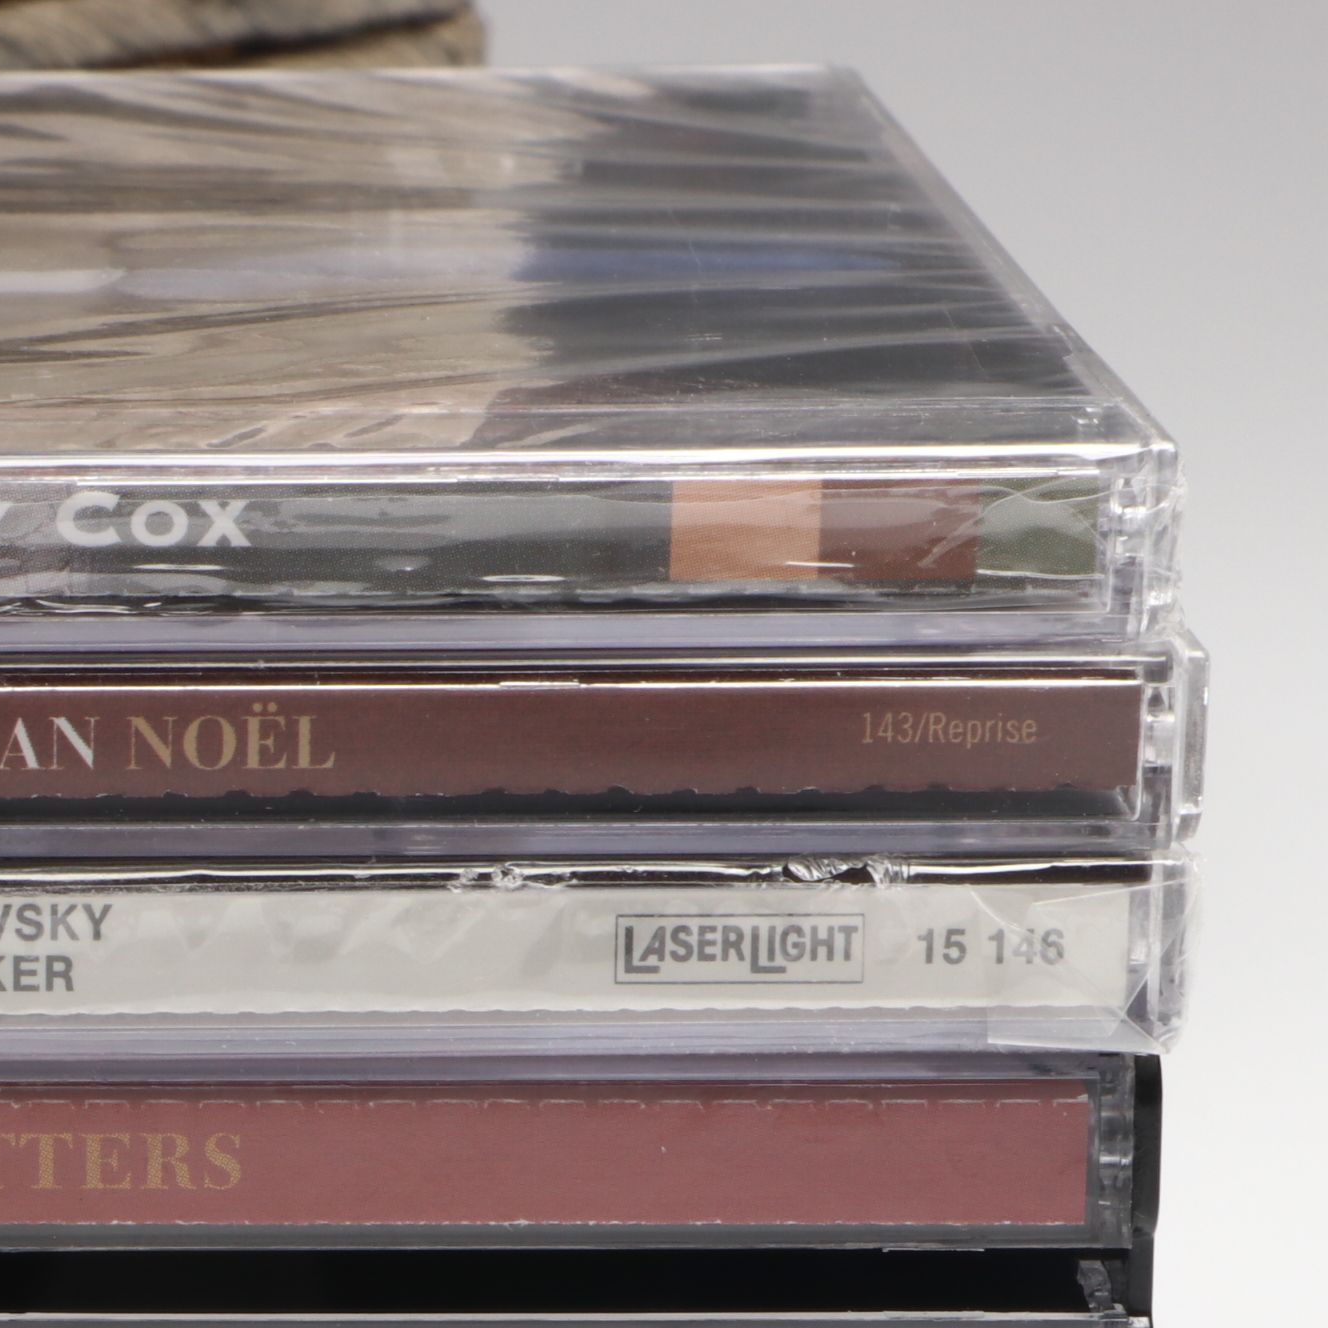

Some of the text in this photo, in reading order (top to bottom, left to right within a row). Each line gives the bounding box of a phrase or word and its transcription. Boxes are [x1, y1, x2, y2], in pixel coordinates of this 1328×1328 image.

[56, 491, 252, 547] COX
[127, 702, 336, 770] NOËL
[861, 712, 1038, 746] 143/Reprise
[917, 928, 1065, 965] 15 146
